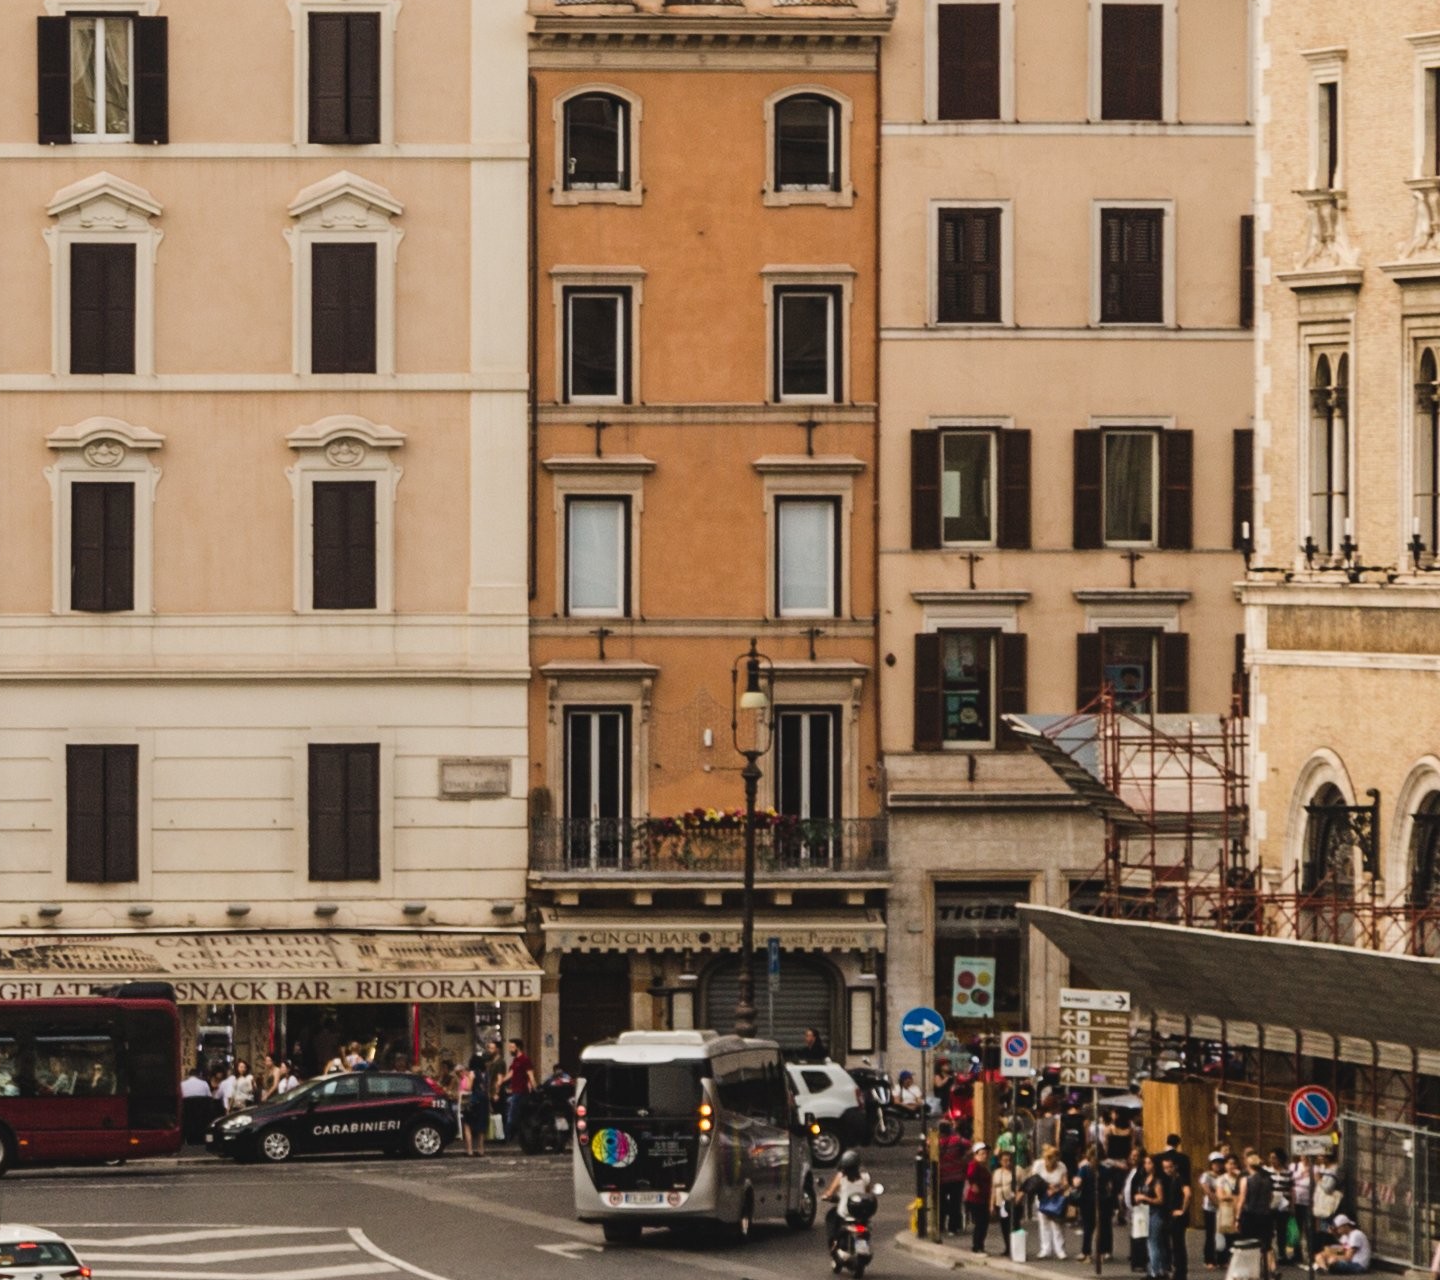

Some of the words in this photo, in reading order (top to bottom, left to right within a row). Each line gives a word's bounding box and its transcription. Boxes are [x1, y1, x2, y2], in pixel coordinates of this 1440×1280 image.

[938, 905, 1019, 920] TIGER
[590, 931, 620, 945] CIN
[624, 931, 655, 945] CIN
[659, 931, 691, 945] BAR
[178, 949, 335, 959] GELATERIA
[173, 961, 352, 971] RISTORANTE
[175, 981, 268, 1002] SNACK
[277, 981, 333, 1000] BAR
[356, 979, 534, 999] RISTORANTE
[432, 1099, 447, 1109] 112
[313, 1120, 401, 1136] CARABINIERI
